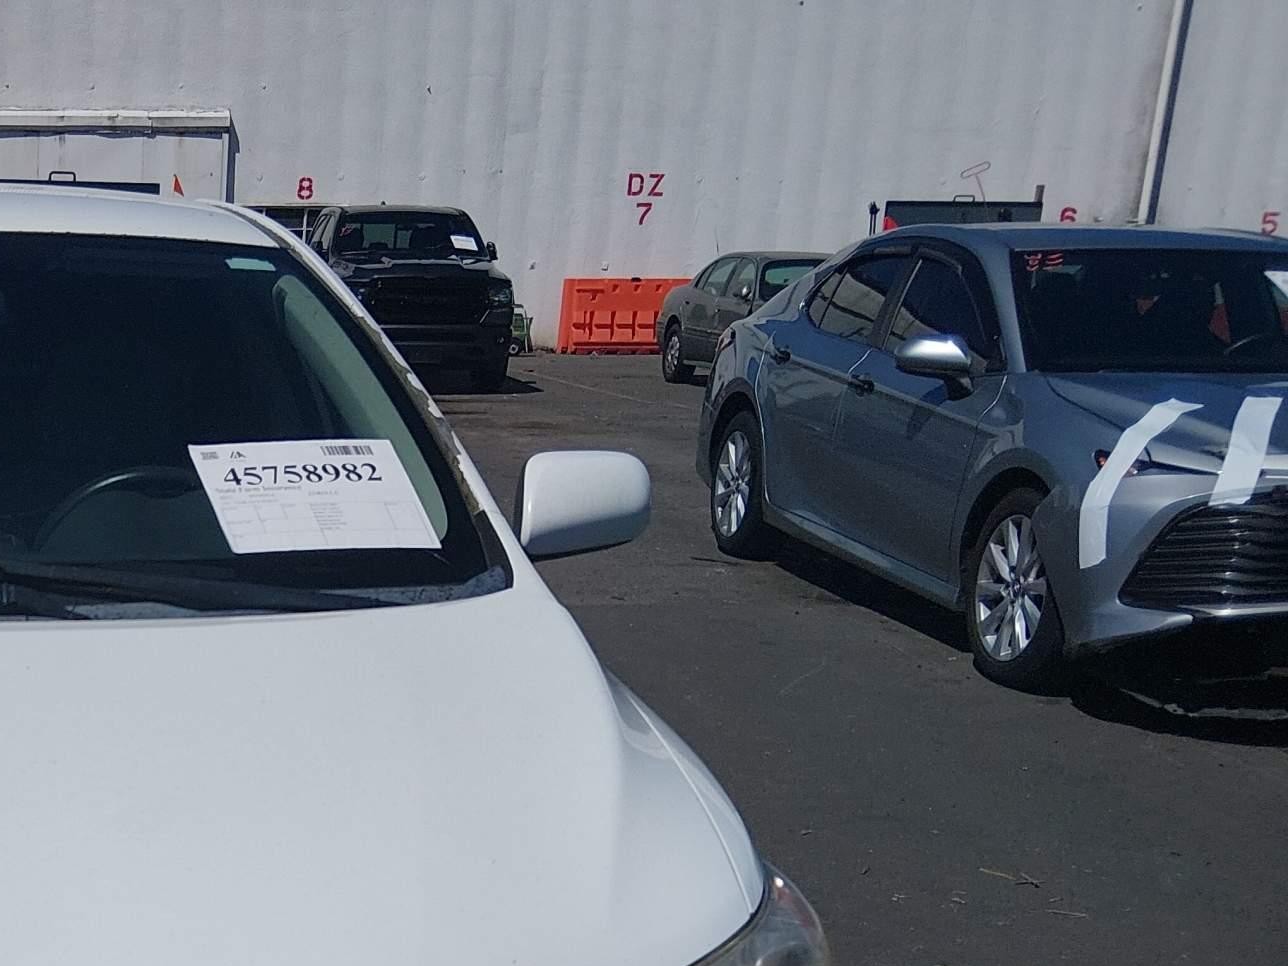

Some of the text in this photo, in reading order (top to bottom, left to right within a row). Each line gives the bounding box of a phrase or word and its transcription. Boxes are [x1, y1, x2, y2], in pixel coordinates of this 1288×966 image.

[297, 177, 314, 200] 8
[627, 172, 665, 198] DZ
[636, 202, 652, 226] 7
[1261, 211, 1281, 235] 5
[223, 463, 382, 486] 45758982
